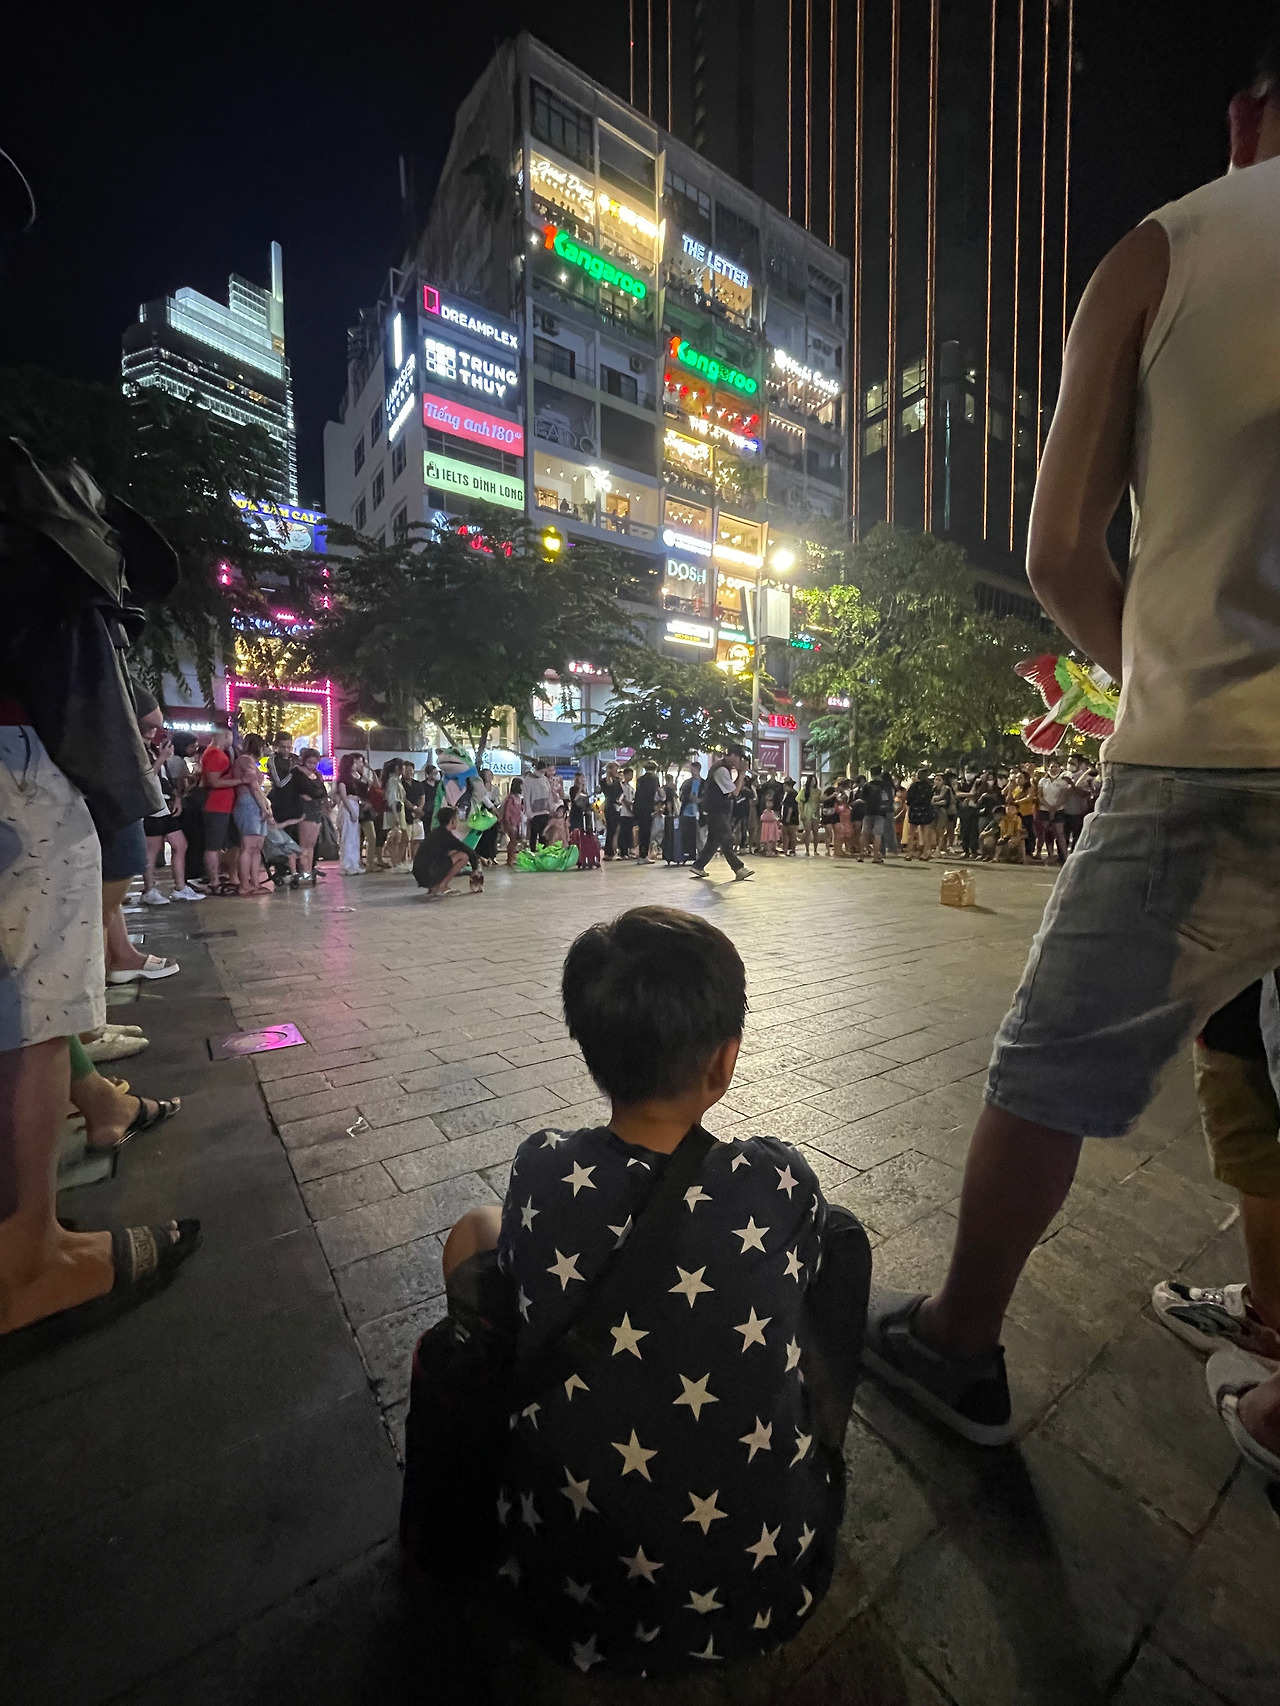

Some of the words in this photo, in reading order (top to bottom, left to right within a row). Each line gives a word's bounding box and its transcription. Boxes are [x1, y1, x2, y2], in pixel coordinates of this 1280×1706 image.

[682, 234, 706, 263] THE
[706, 250, 749, 289] LETTER
[441, 305, 518, 349] DREAMPLEX
[459, 351, 518, 385] TRUNG
[459, 368, 507, 399] THUY
[424, 402, 461, 430] Tiếng
[442, 468, 469, 487] IELTS
[473, 477, 496, 494] ĐÌNH
[499, 484, 523, 501] LONG
